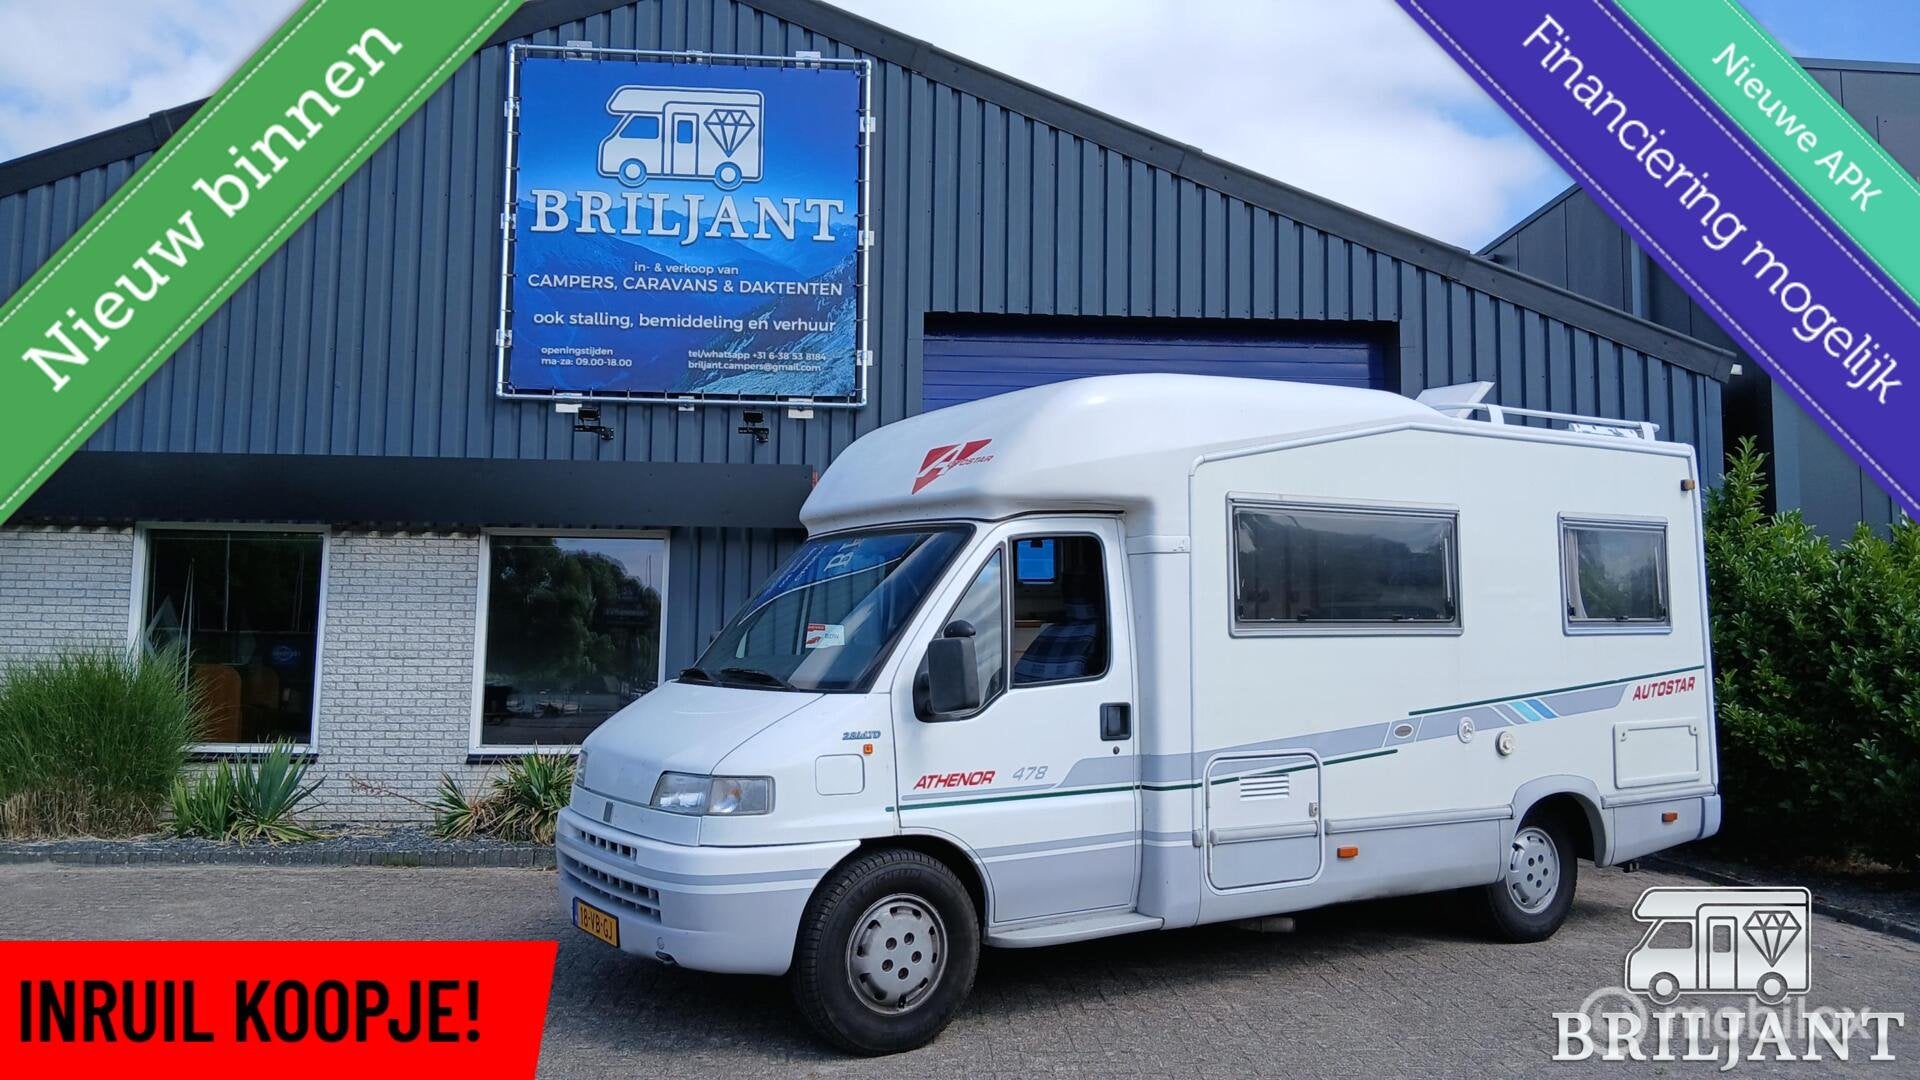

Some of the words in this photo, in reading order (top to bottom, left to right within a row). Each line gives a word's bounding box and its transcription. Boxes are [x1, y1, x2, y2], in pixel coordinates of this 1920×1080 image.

[530, 189, 845, 246] BRILJANT
[634, 262, 650, 273] in-
[654, 263, 663, 273] &
[665, 263, 714, 276] verkoop
[718, 266, 739, 275] van
[528, 273, 618, 290] CAMPERS,
[622, 276, 718, 292] CARAVANS
[723, 279, 734, 293] &
[739, 280, 843, 296] DAKTENTEN
[533, 311, 564, 326] ook
[569, 312, 634, 329] stalling,
[639, 313, 743, 332] bemiddeling
[748, 319, 769, 331] en
[773, 318, 836, 333] verhuur
[541, 346, 613, 357] openingstijden
[541, 358, 574, 367] ma-za:
[575, 357, 632, 367] 09.00-18.00
[688, 350, 750, 361] tel/whatsapp
[752, 351, 767, 360] +31
[768, 351, 790, 360] 6-38
[792, 352, 803, 360] 53
[805, 353, 826, 361] 8184
[688, 361, 822, 372] briljant.campers@gmail.com
[1632, 676, 1697, 701] AUTOSTAR
[913, 770, 996, 790] ATHENOR
[1012, 765, 1049, 780] 478
[580, 905, 613, 940] 18-VB-GJ
